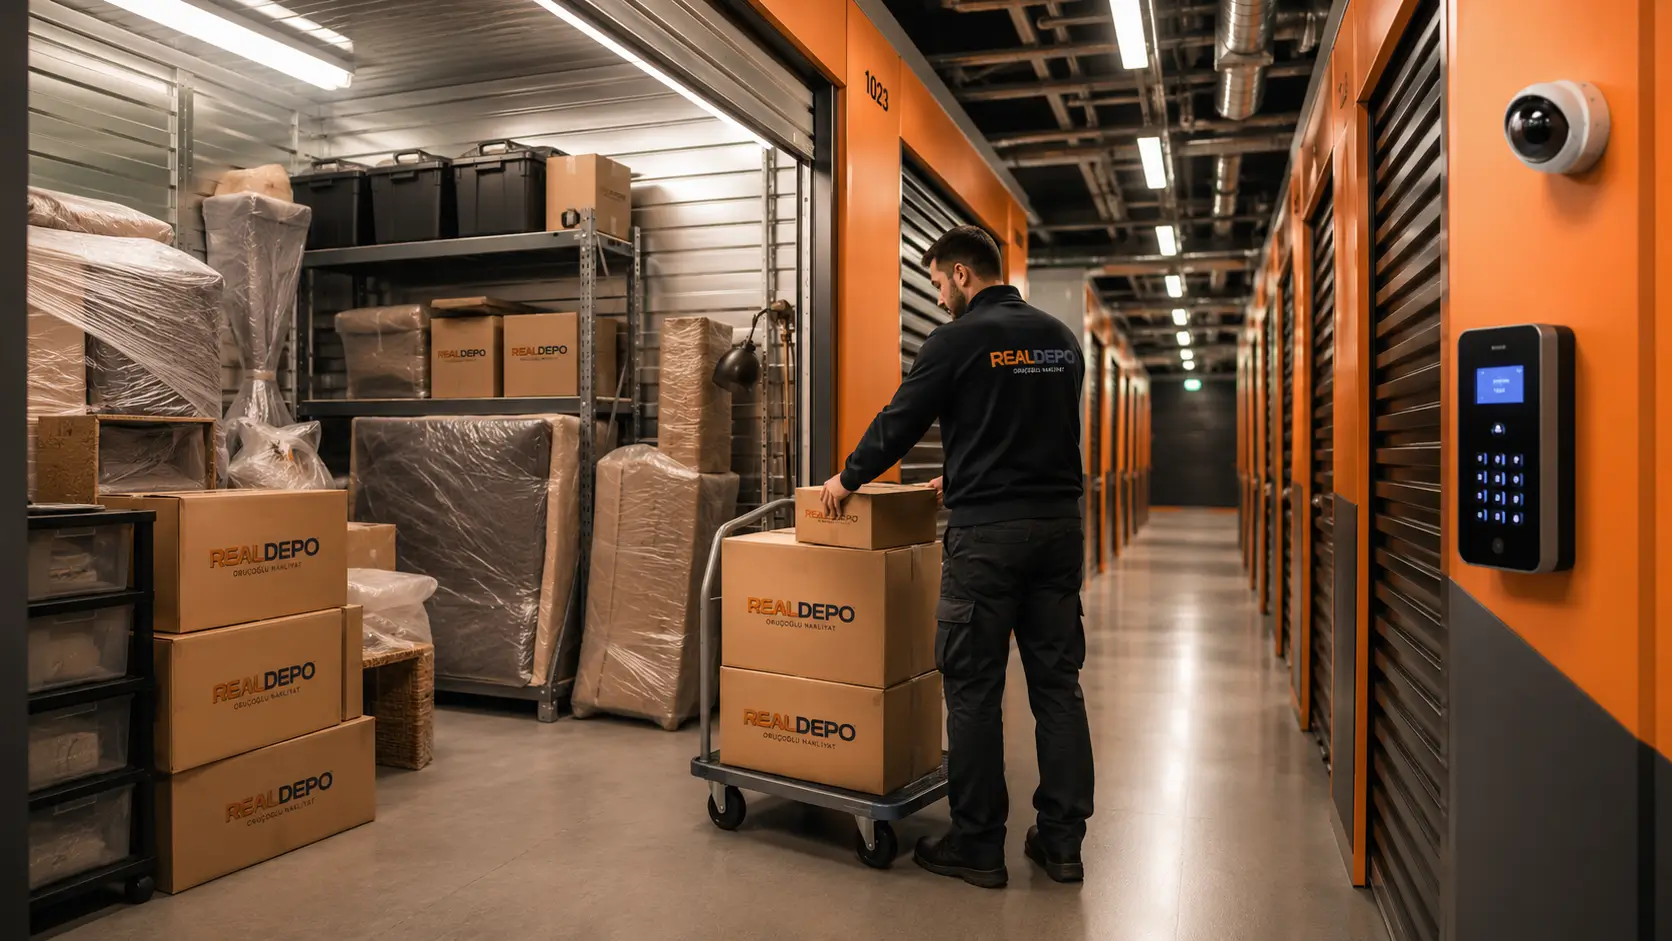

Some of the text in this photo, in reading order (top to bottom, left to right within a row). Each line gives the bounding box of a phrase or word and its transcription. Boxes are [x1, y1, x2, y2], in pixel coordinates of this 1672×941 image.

[865, 70, 888, 112] 1023
[437, 349, 486, 359] REALDEPO
[512, 345, 568, 357] REALDEPO
[990, 349, 1076, 368] REALDEPO
[209, 537, 320, 569] REALDEPO
[747, 596, 855, 623] REALDEPO
[212, 661, 316, 705] REALDEPO
[743, 708, 856, 742] REALDEPO
[225, 771, 333, 824] REALDEPO
